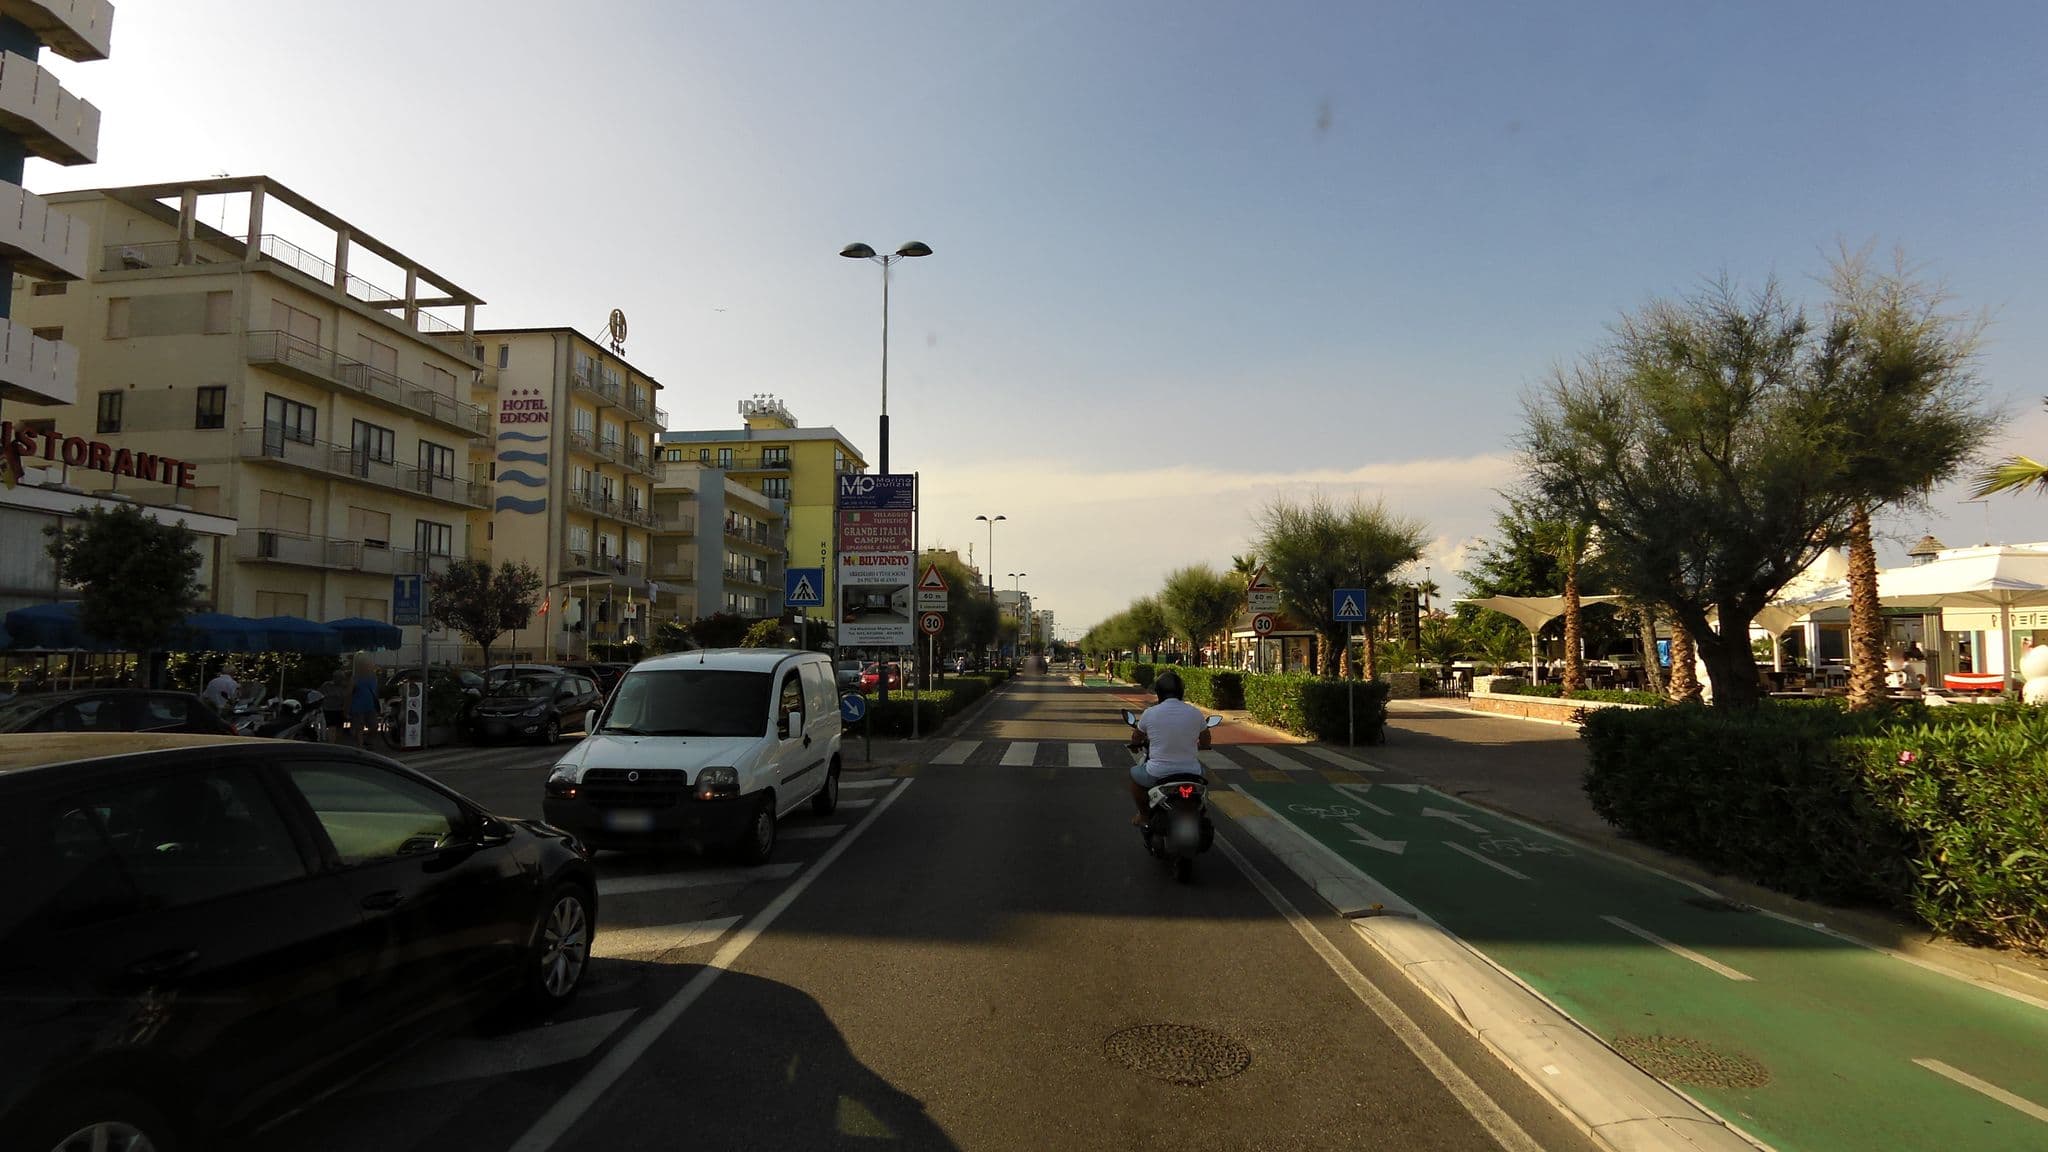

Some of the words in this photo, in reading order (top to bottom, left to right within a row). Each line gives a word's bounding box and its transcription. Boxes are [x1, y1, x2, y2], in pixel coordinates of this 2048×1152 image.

[502, 399, 547, 411] HOTEL
[500, 411, 549, 424] EDISON
[844, 527, 877, 536] GRANDE
[879, 527, 907, 536] ITALIA
[843, 555, 909, 566] MBILVENETO
[926, 618, 939, 629] 30
[1257, 619, 1271, 630] 30
